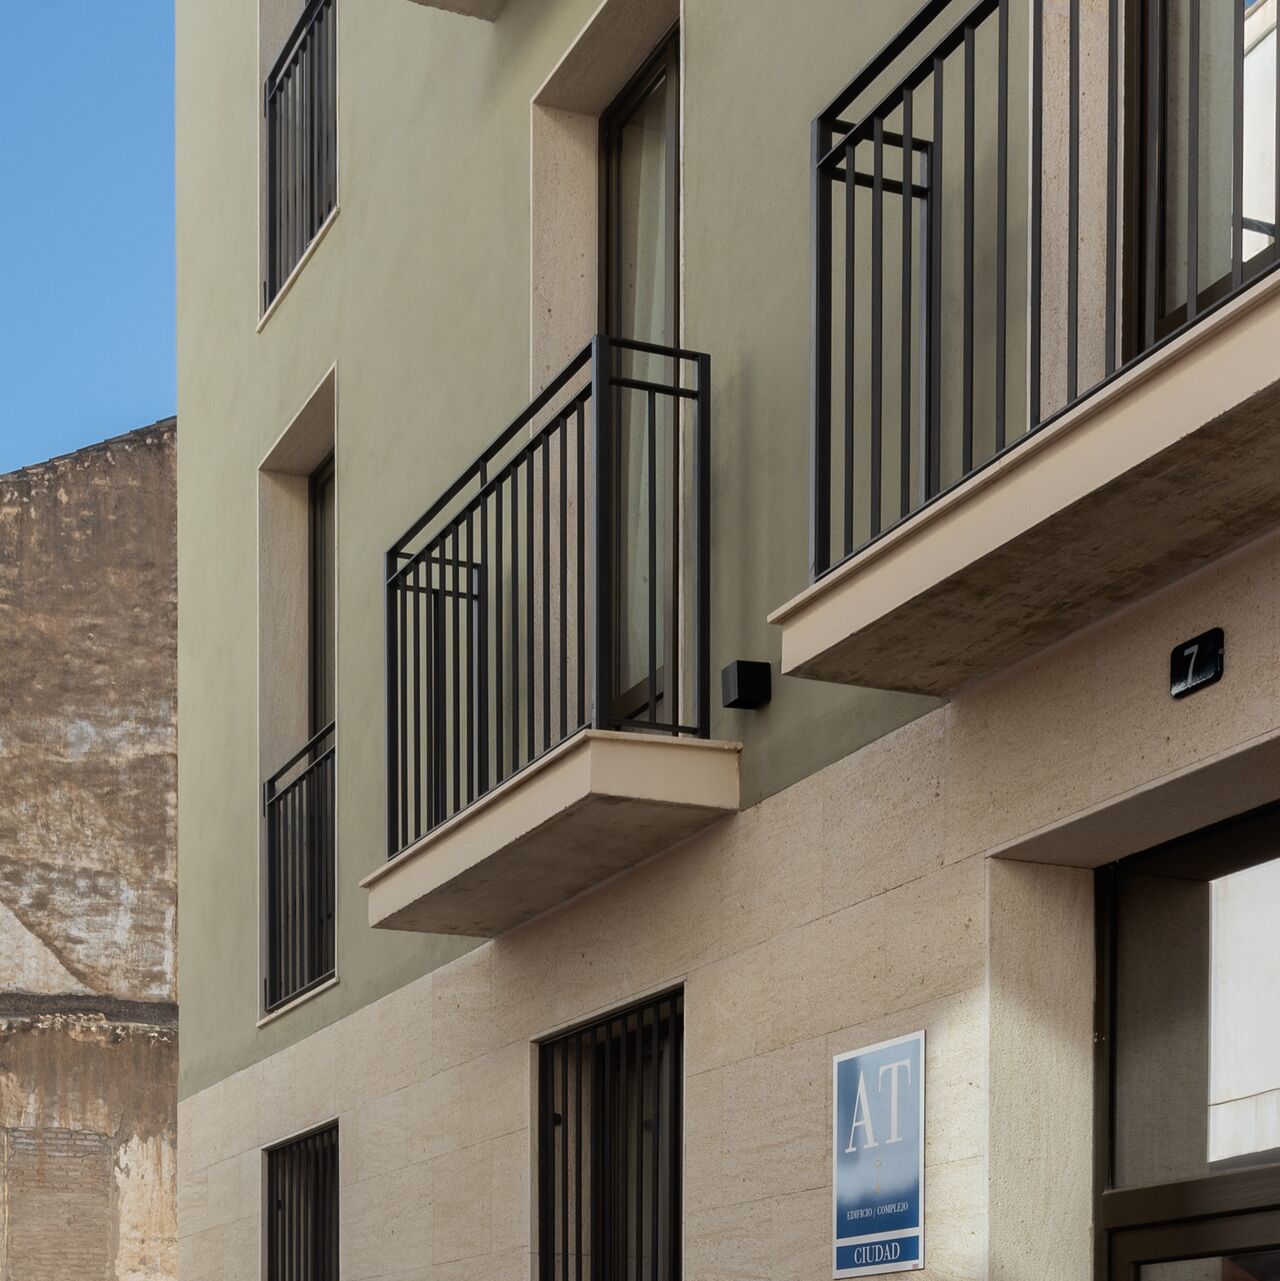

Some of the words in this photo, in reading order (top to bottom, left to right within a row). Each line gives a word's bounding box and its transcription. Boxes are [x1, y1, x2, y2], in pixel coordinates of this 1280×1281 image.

[1184, 644, 1199, 687] 7
[845, 1058, 911, 1153] AT
[847, 1208, 873, 1220] EDIFICIO
[877, 1201, 909, 1216] COMPLEJO
[854, 1242, 900, 1264] CIUDAD
